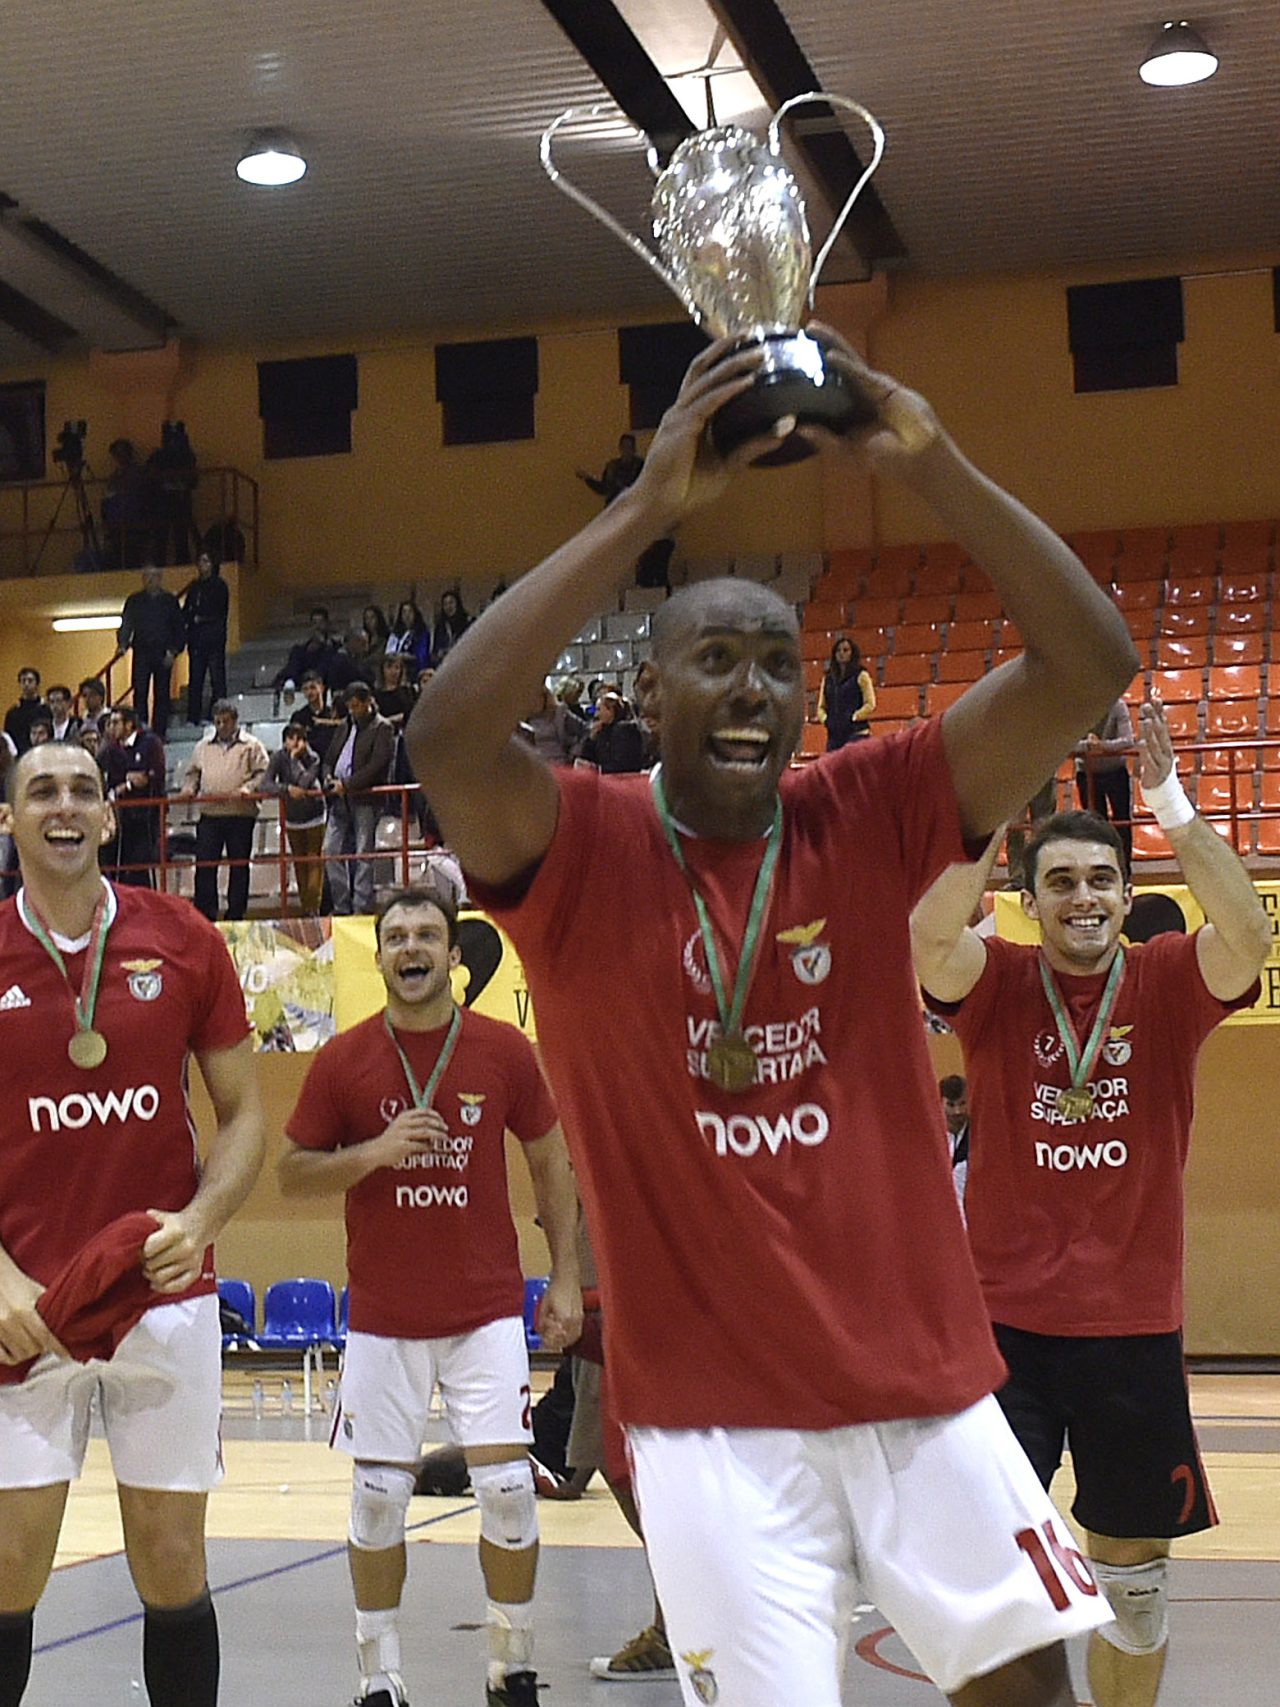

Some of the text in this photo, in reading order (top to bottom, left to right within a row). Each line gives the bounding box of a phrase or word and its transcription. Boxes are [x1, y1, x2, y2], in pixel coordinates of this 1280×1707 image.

[1044, 1035, 1055, 1051] 7
[28, 1084, 160, 1132] nowo
[695, 1103, 829, 1157] nowo
[1034, 1140, 1128, 1172] nowo
[396, 1185, 468, 1208] nowo
[1171, 1463, 1197, 1526] 7
[1014, 1520, 1098, 1613] 16
